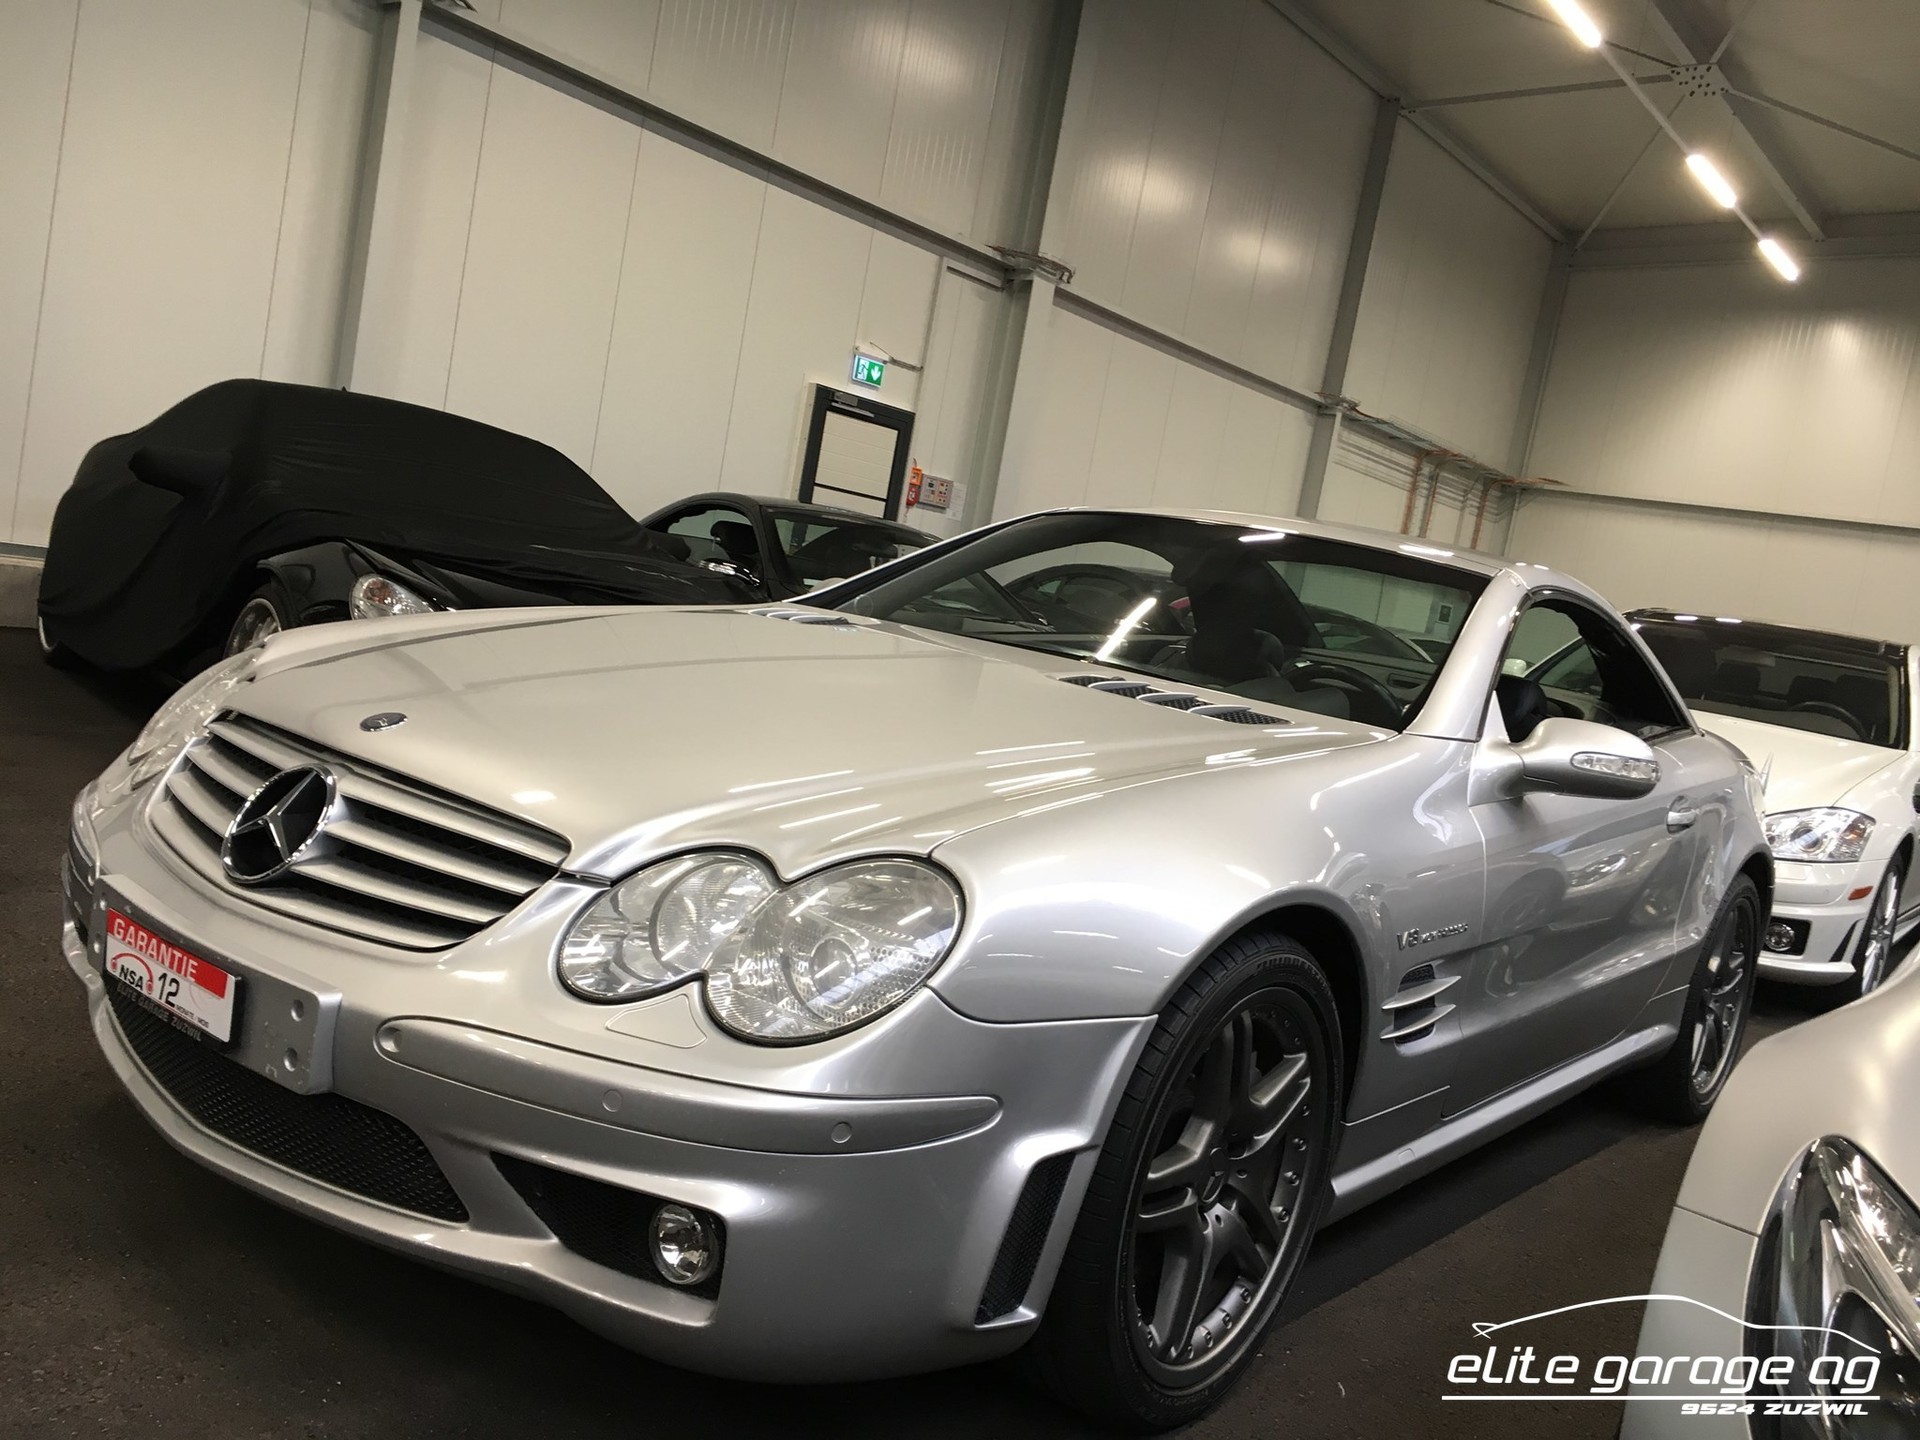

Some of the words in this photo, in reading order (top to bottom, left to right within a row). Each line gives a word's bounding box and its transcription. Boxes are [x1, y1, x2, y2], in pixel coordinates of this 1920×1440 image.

[113, 918, 199, 983] GARANTIE
[1396, 927, 1420, 952] V8
[119, 964, 144, 991] NSA
[158, 972, 180, 1008] 12
[116, 981, 138, 1002] ELITE
[170, 1015, 202, 1042] ZUZWIL
